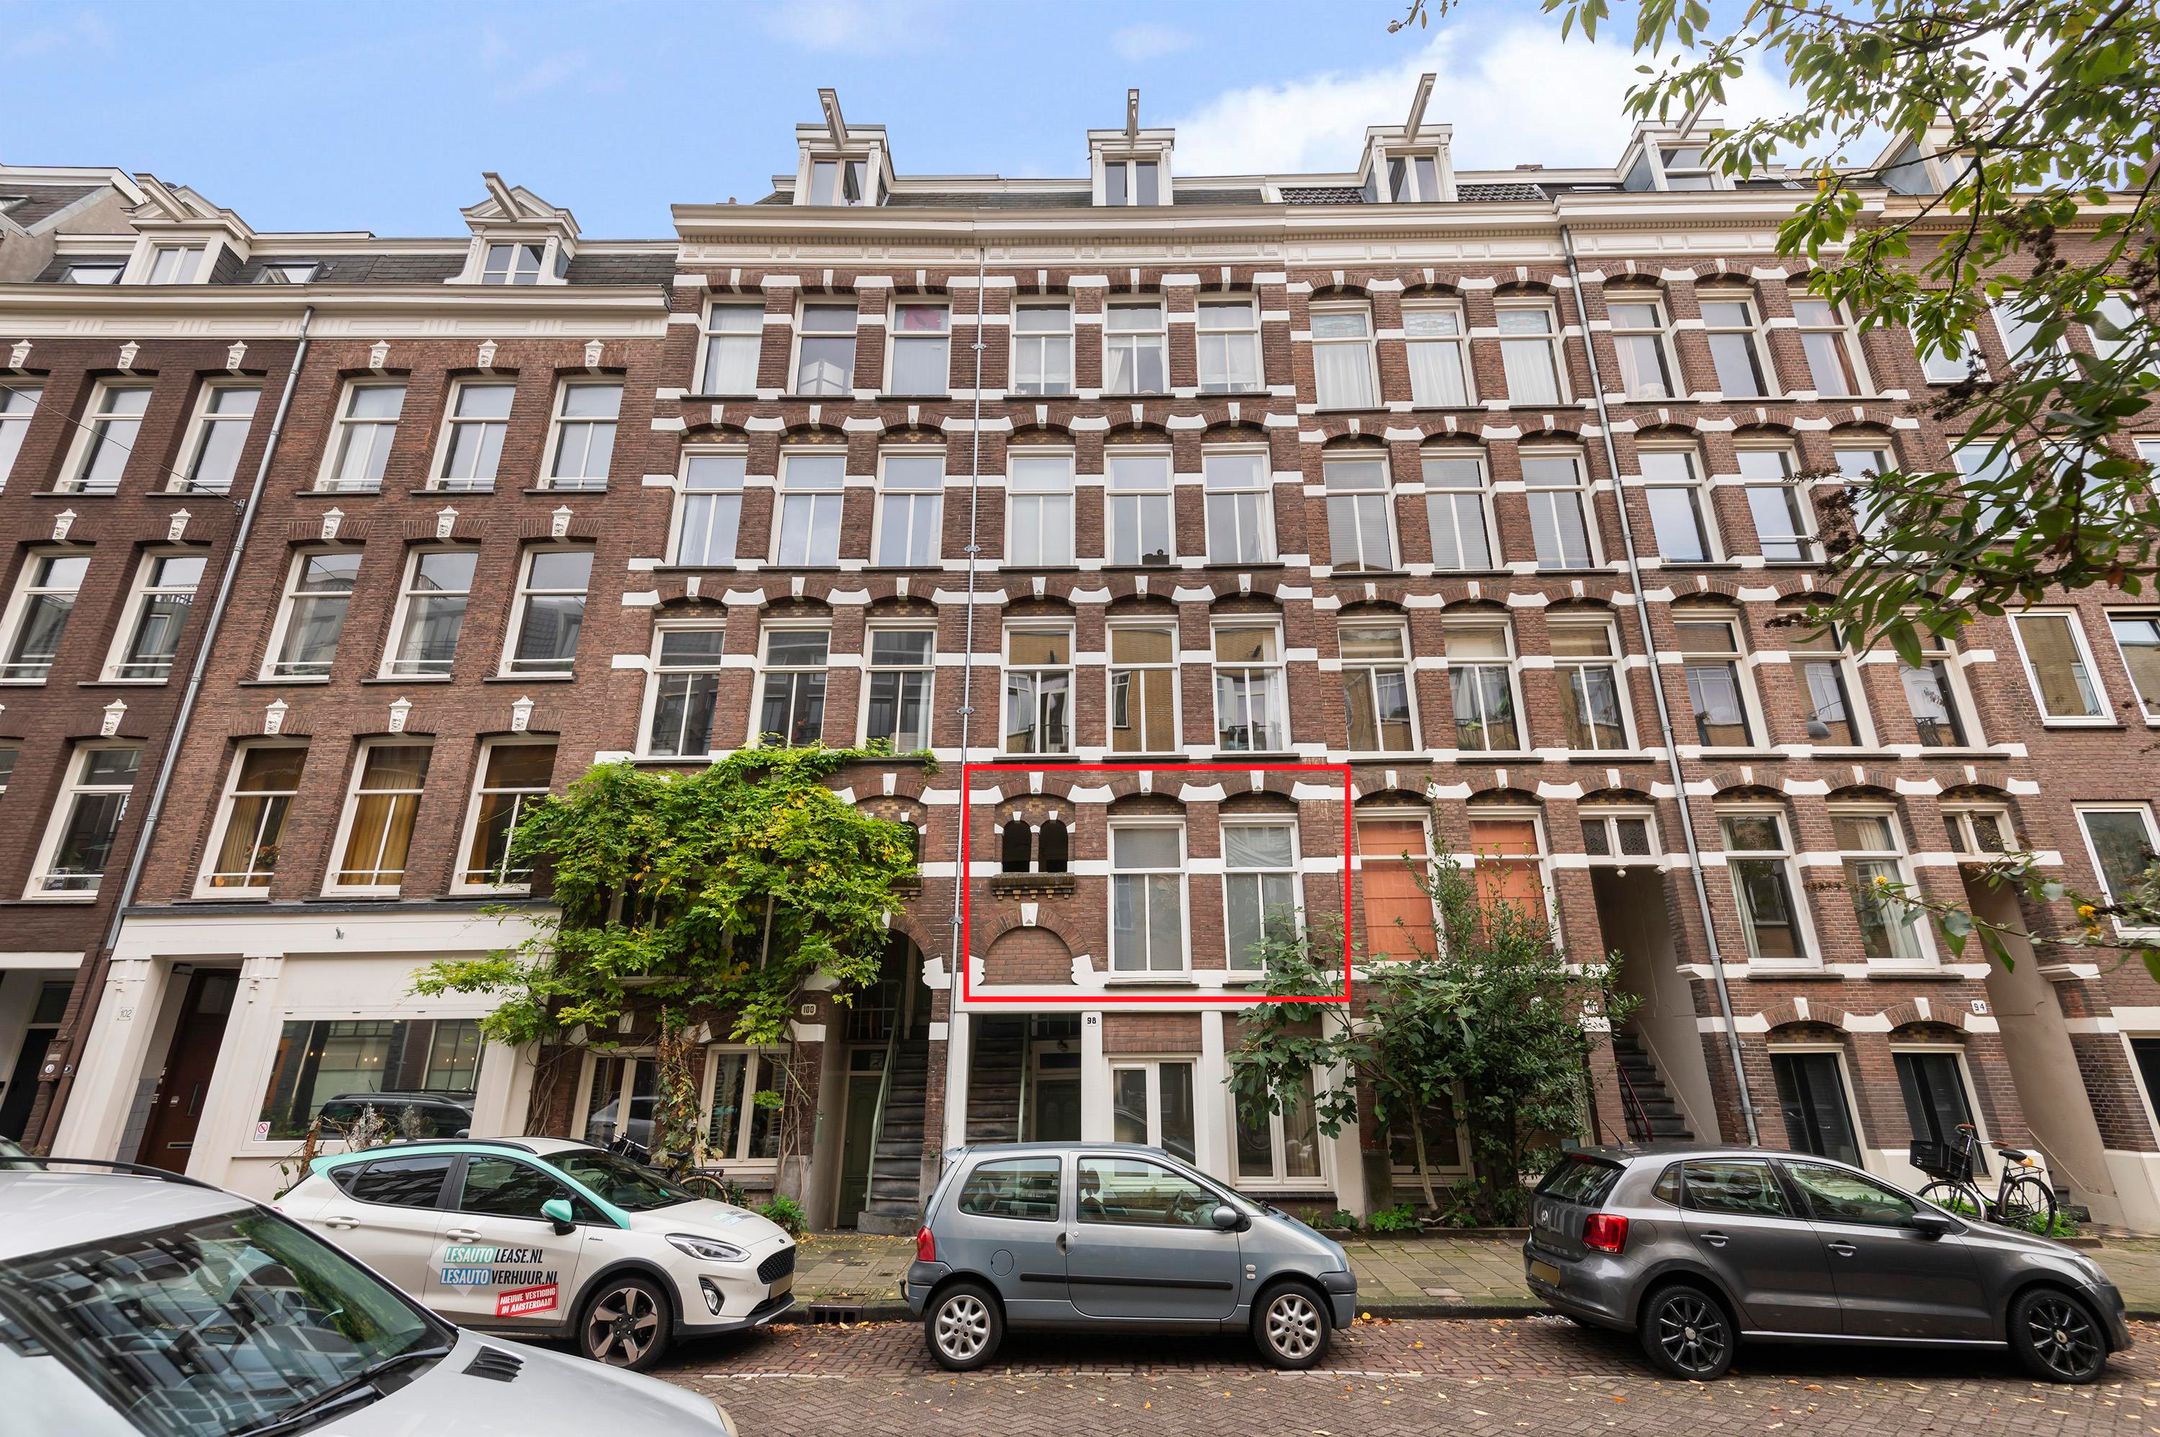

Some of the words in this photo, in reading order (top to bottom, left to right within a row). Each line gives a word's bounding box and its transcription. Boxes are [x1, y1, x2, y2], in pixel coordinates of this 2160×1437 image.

[1973, 1002, 1985, 1011] 94
[1086, 1016, 1097, 1025] 98
[500, 1293, 524, 1305] NIEUWE
[525, 1287, 556, 1300] VESTIGING
[501, 1305, 510, 1314] IN
